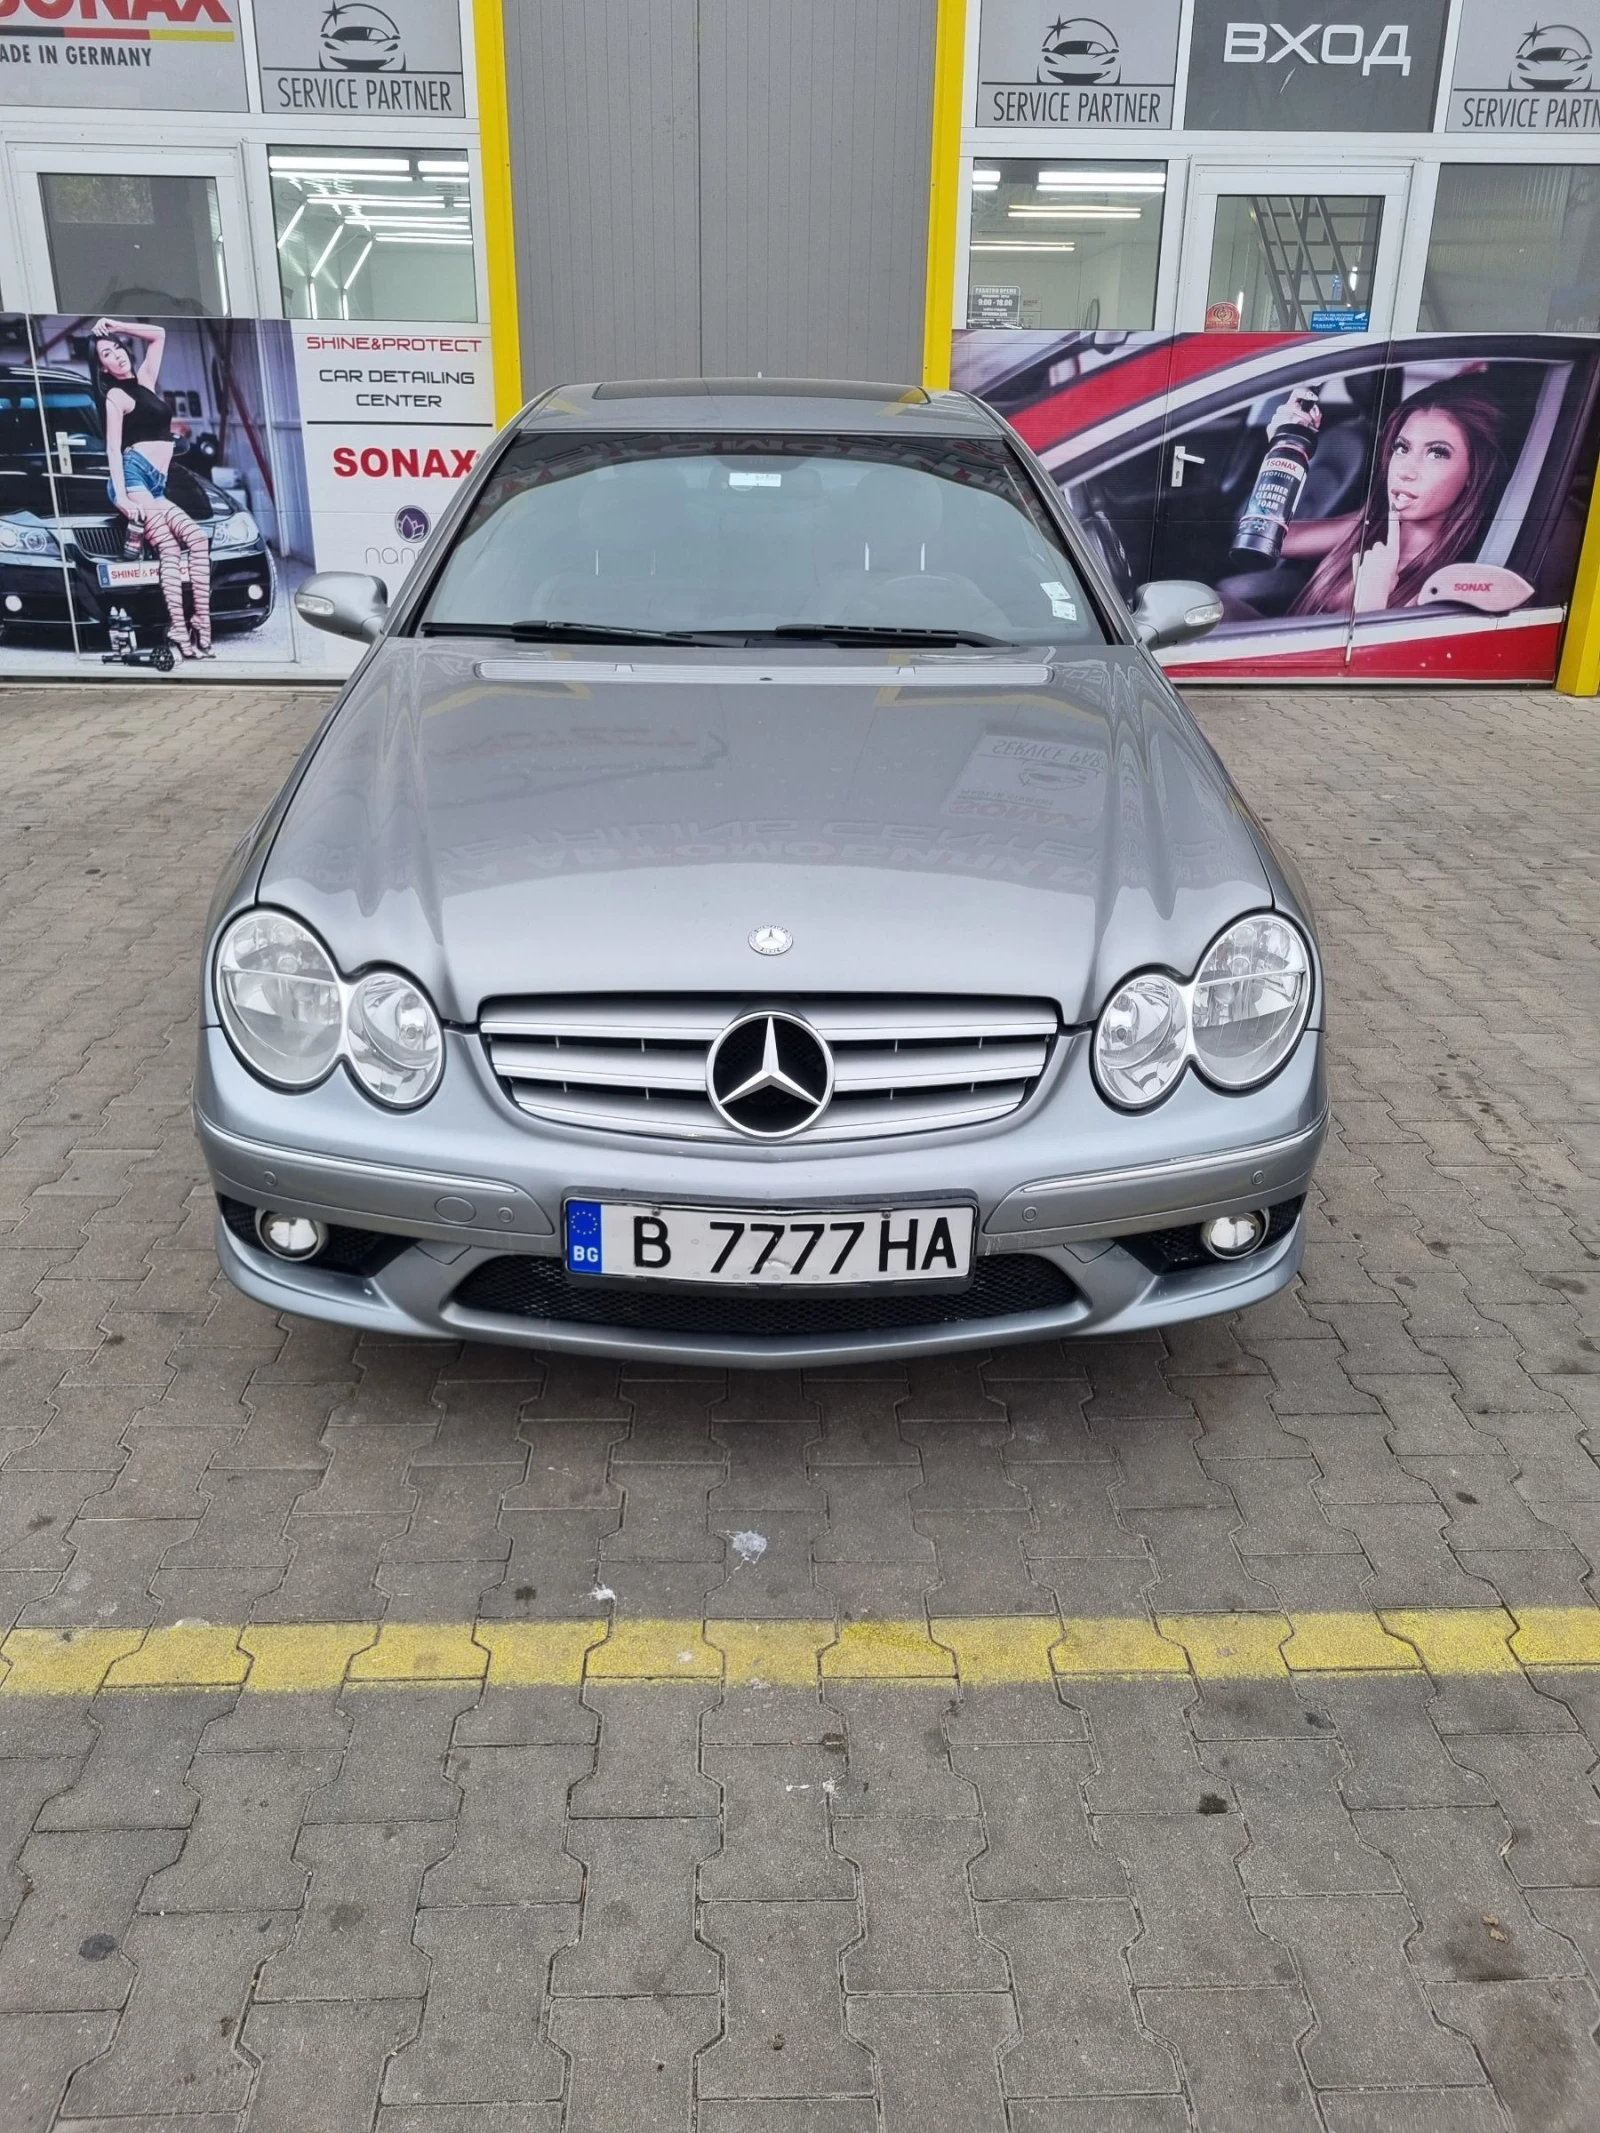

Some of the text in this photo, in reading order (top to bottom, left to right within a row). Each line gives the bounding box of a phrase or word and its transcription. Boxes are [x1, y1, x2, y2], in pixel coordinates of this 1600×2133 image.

[39, 45, 58, 64] IN
[66, 46, 152, 67] GERMANY
[1223, 22, 1412, 77] ВХОД
[277, 77, 452, 111] SERVICE PARTNER
[993, 91, 1161, 123] SERVICE PARTNER
[1462, 97, 1541, 128] SERVICE
[306, 336, 482, 353] SHINE&PROTECT
[319, 369, 475, 385] CAR DETAILING
[356, 394, 442, 408] CENTER
[333, 447, 477, 478] SONAX
[1269, 460, 1298, 472] SONAX
[1261, 470, 1295, 483] PROFILINE
[1255, 491, 1287, 505] CLEANER
[1258, 483, 1289, 497] LEATHER
[1257, 499, 1280, 511] FOAM
[365, 547, 424, 565] nan
[111, 568, 140, 579] SHINE
[1453, 583, 1492, 592] SONAX
[572, 1245, 599, 1262] BG
[633, 1215, 958, 1275] B 7777 HA
